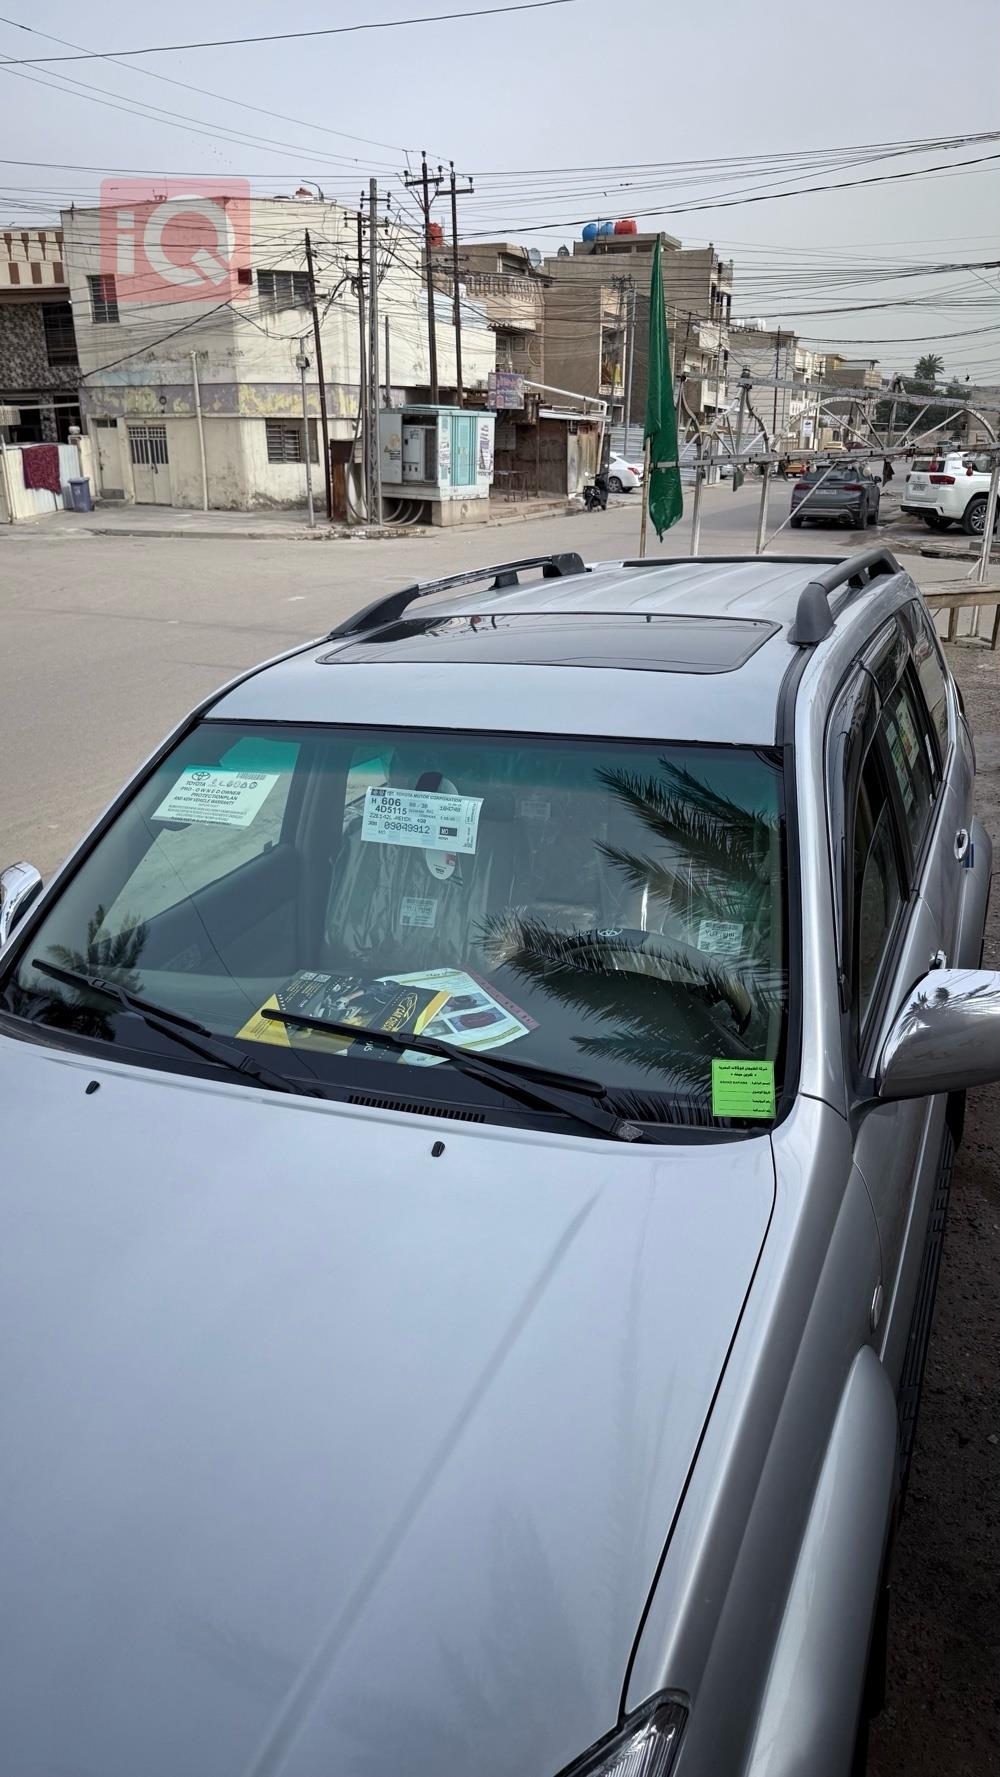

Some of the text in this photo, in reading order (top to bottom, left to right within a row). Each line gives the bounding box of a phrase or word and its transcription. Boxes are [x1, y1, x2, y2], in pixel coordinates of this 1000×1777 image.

[381, 797, 402, 807] 606
[430, 795, 462, 803] CORPORATION
[375, 805, 408, 816] 4D5115
